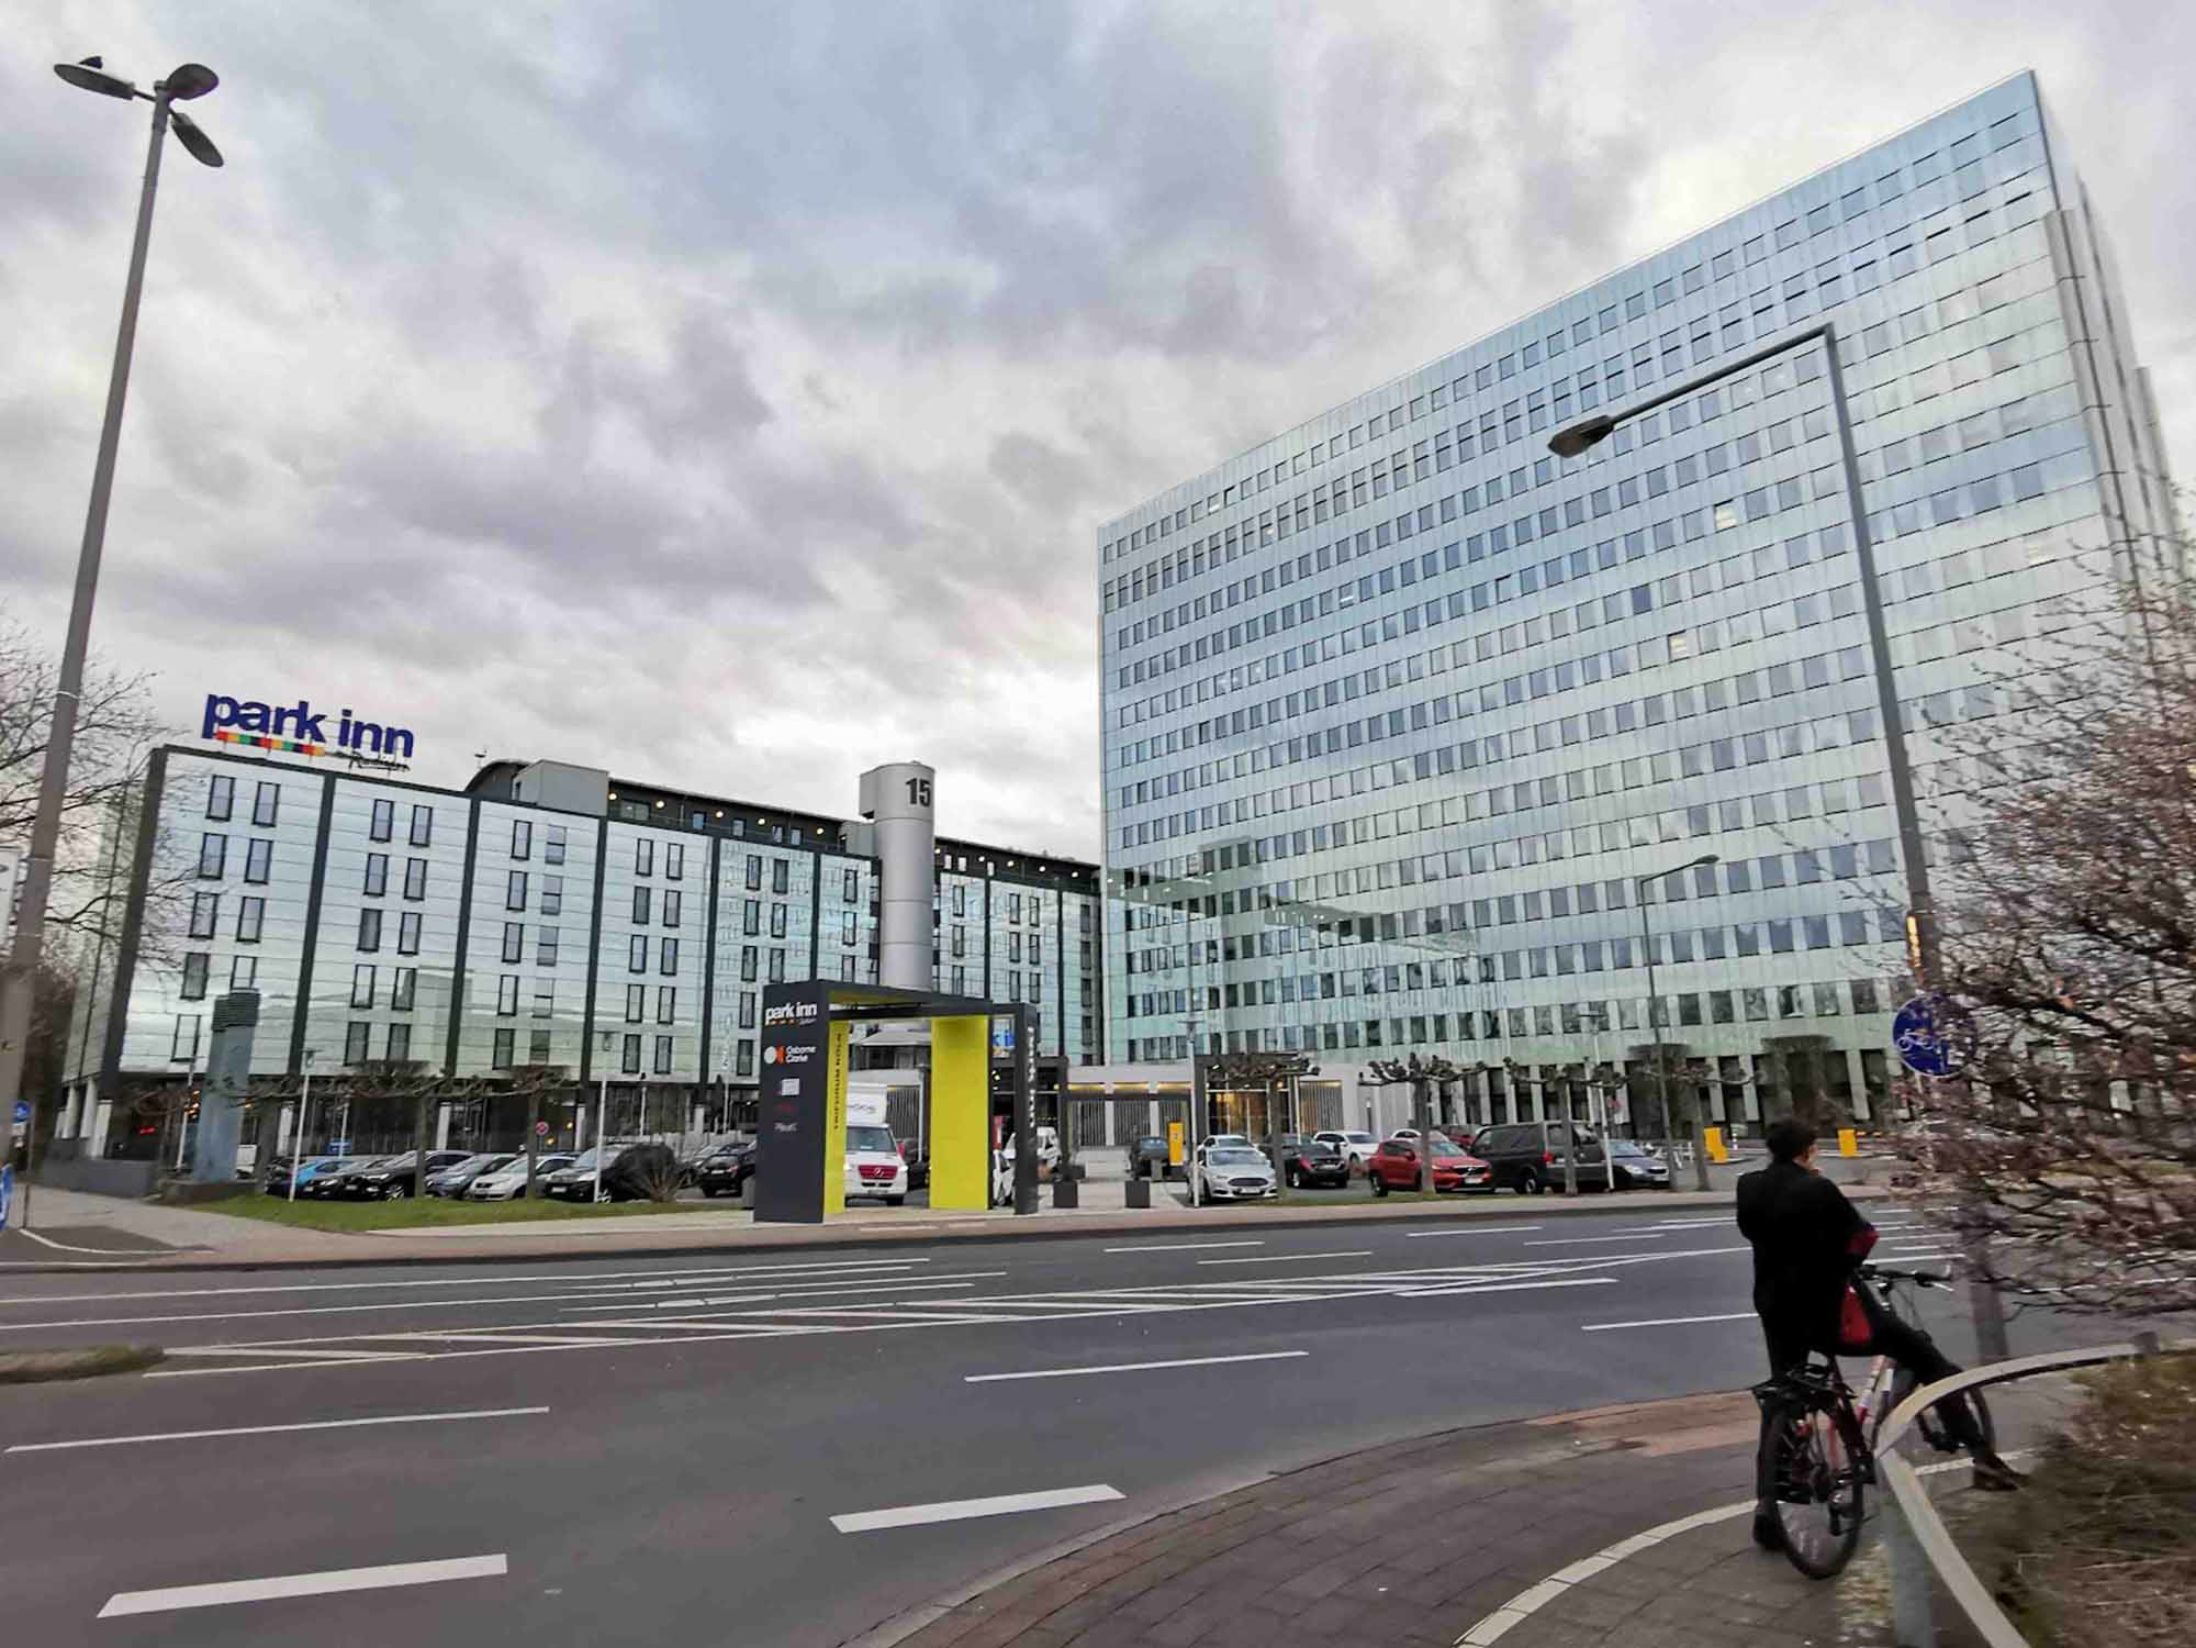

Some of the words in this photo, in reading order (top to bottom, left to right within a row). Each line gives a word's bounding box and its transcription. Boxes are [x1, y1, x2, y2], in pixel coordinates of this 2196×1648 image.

[202, 694, 327, 743] park
[338, 709, 414, 758] inn
[905, 778, 931, 807] 15
[765, 1003, 795, 1026] park
[796, 1002, 818, 1017] inn
